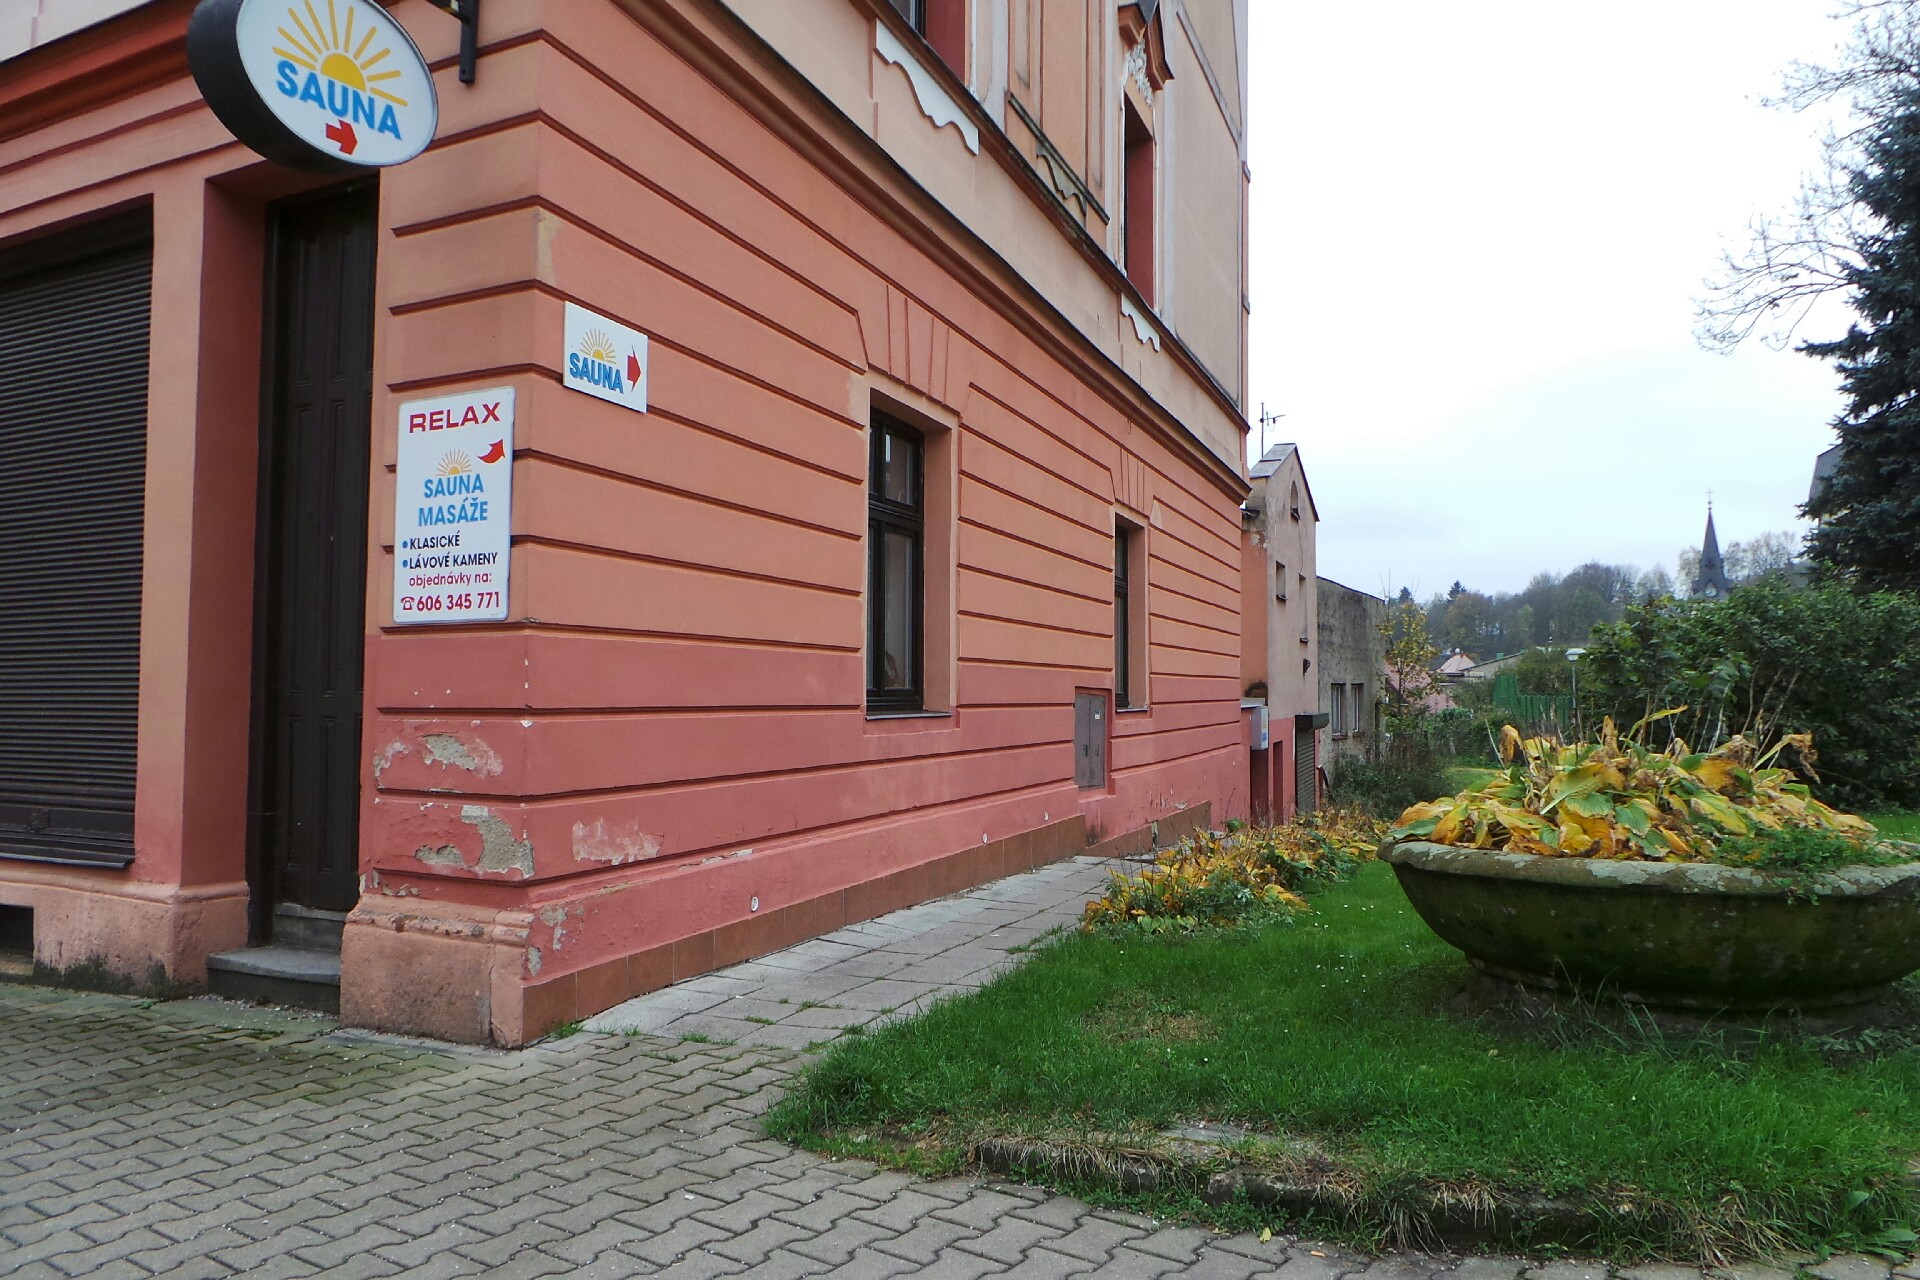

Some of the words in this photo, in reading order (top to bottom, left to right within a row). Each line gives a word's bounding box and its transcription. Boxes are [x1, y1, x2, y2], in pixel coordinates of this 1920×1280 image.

[277, 60, 402, 141] SAUNA
[570, 353, 624, 395] SAUNA
[409, 402, 501, 433] RELAX
[424, 473, 484, 498] SAUNA
[418, 497, 488, 527] MASÁŽE
[410, 531, 460, 550] KLASICKÉ
[409, 553, 450, 570] LÁVOVÉ
[453, 552, 498, 567] KAMENY
[409, 571, 471, 588] objednávky
[475, 571, 492, 584] na:
[416, 595, 442, 612] 606
[447, 593, 472, 610] 345
[477, 591, 500, 609] 771
